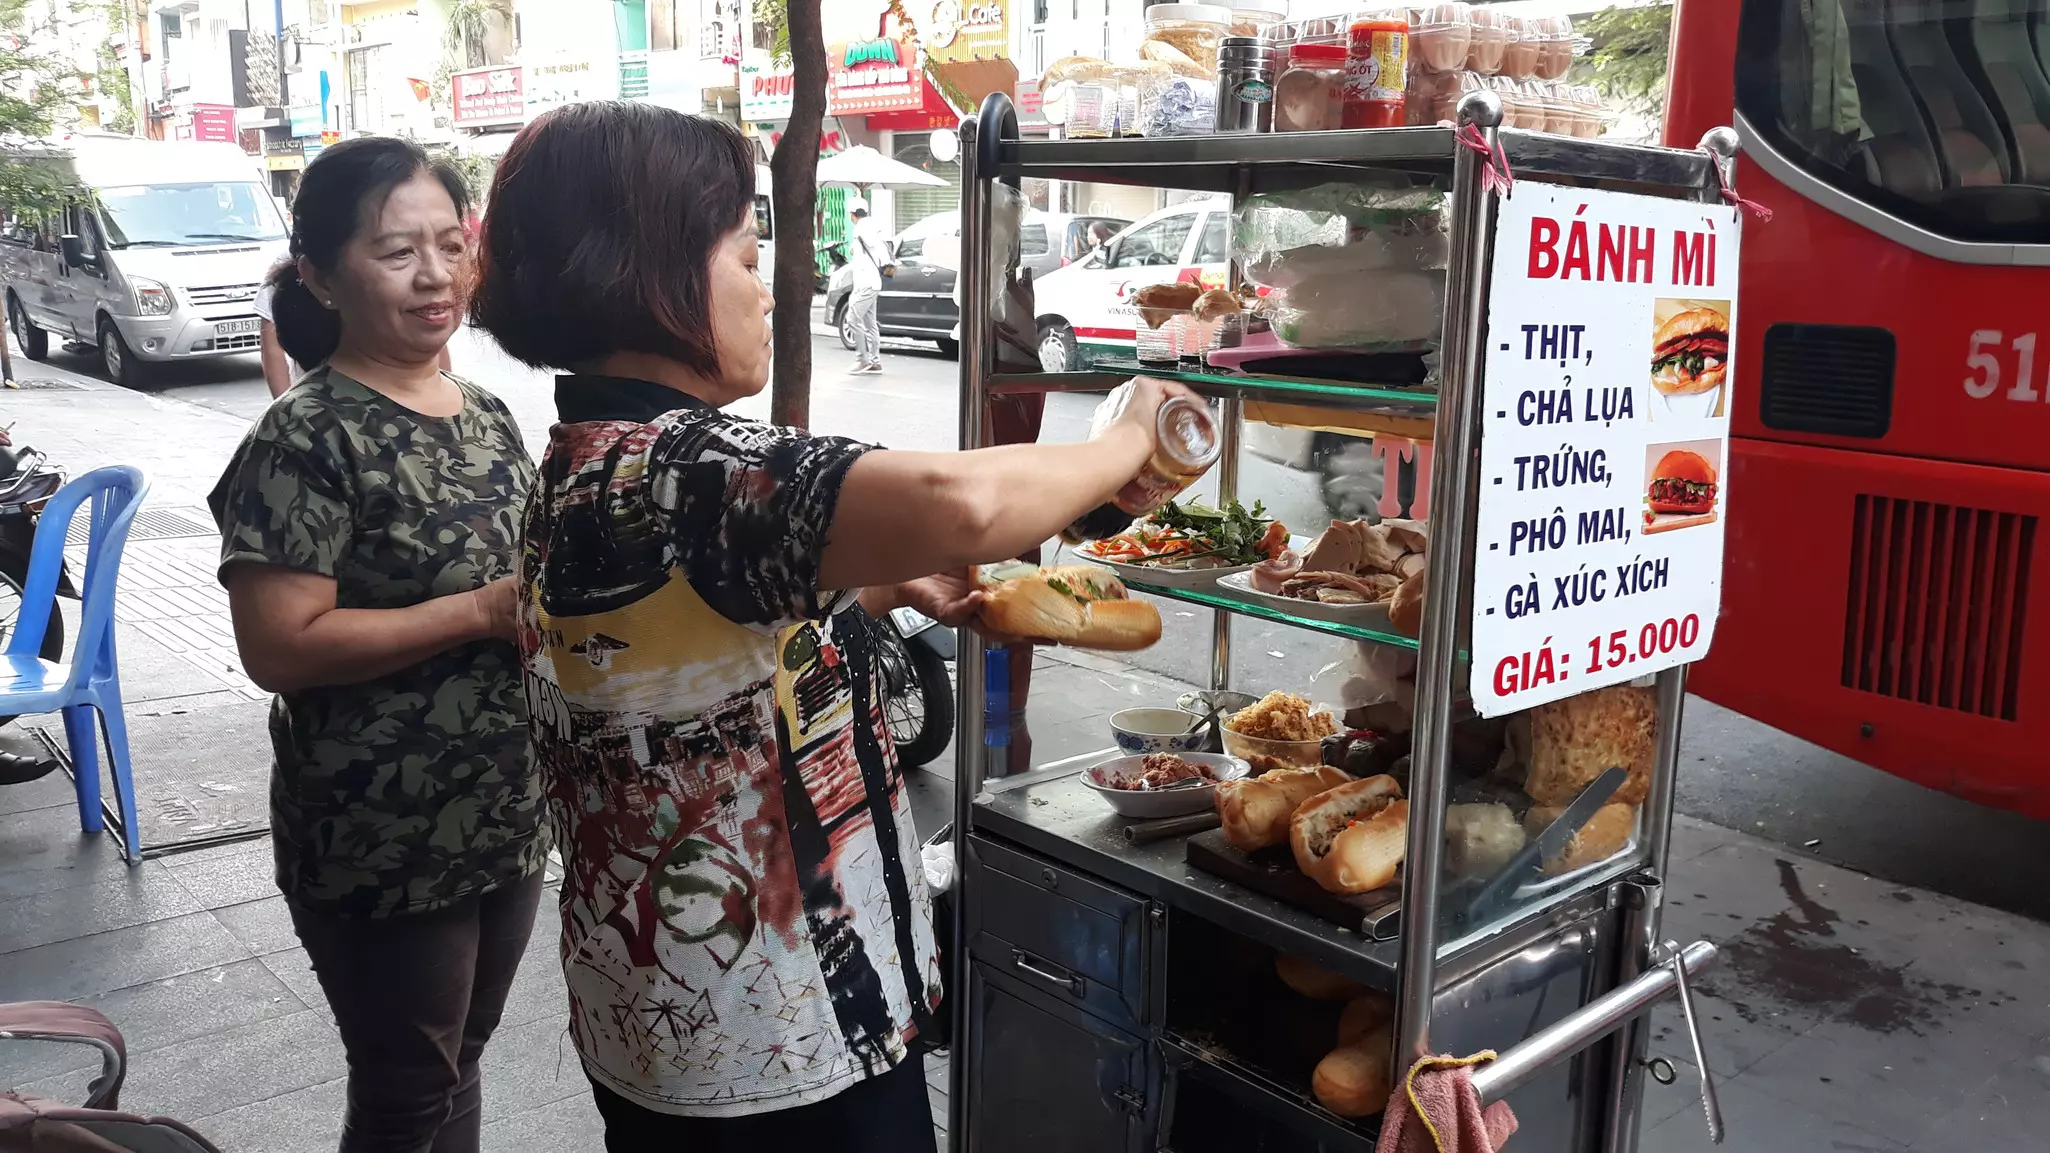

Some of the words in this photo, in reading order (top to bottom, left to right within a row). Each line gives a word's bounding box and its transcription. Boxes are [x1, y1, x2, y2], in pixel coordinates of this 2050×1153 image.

[844, 37, 898, 67] DOWN
[1527, 204, 1655, 284] BÁNH
[1672, 218, 1716, 286] MÌ
[1521, 324, 1593, 368] THỊT,
[1963, 329, 2050, 403] 51
[1517, 375, 1573, 426] CHẢ
[1584, 386, 1634, 428] LỤA
[1513, 443, 1612, 491] TRỨNG,
[1509, 506, 1566, 556] PHÔ
[1577, 507, 1631, 546] MAI,
[1505, 572, 1541, 619] GÀ
[1552, 563, 1607, 611] XÚC
[1614, 554, 1669, 598] XÍCH
[1493, 635, 1570, 697] GIÁ:
[1585, 613, 1699, 674] 15.000
